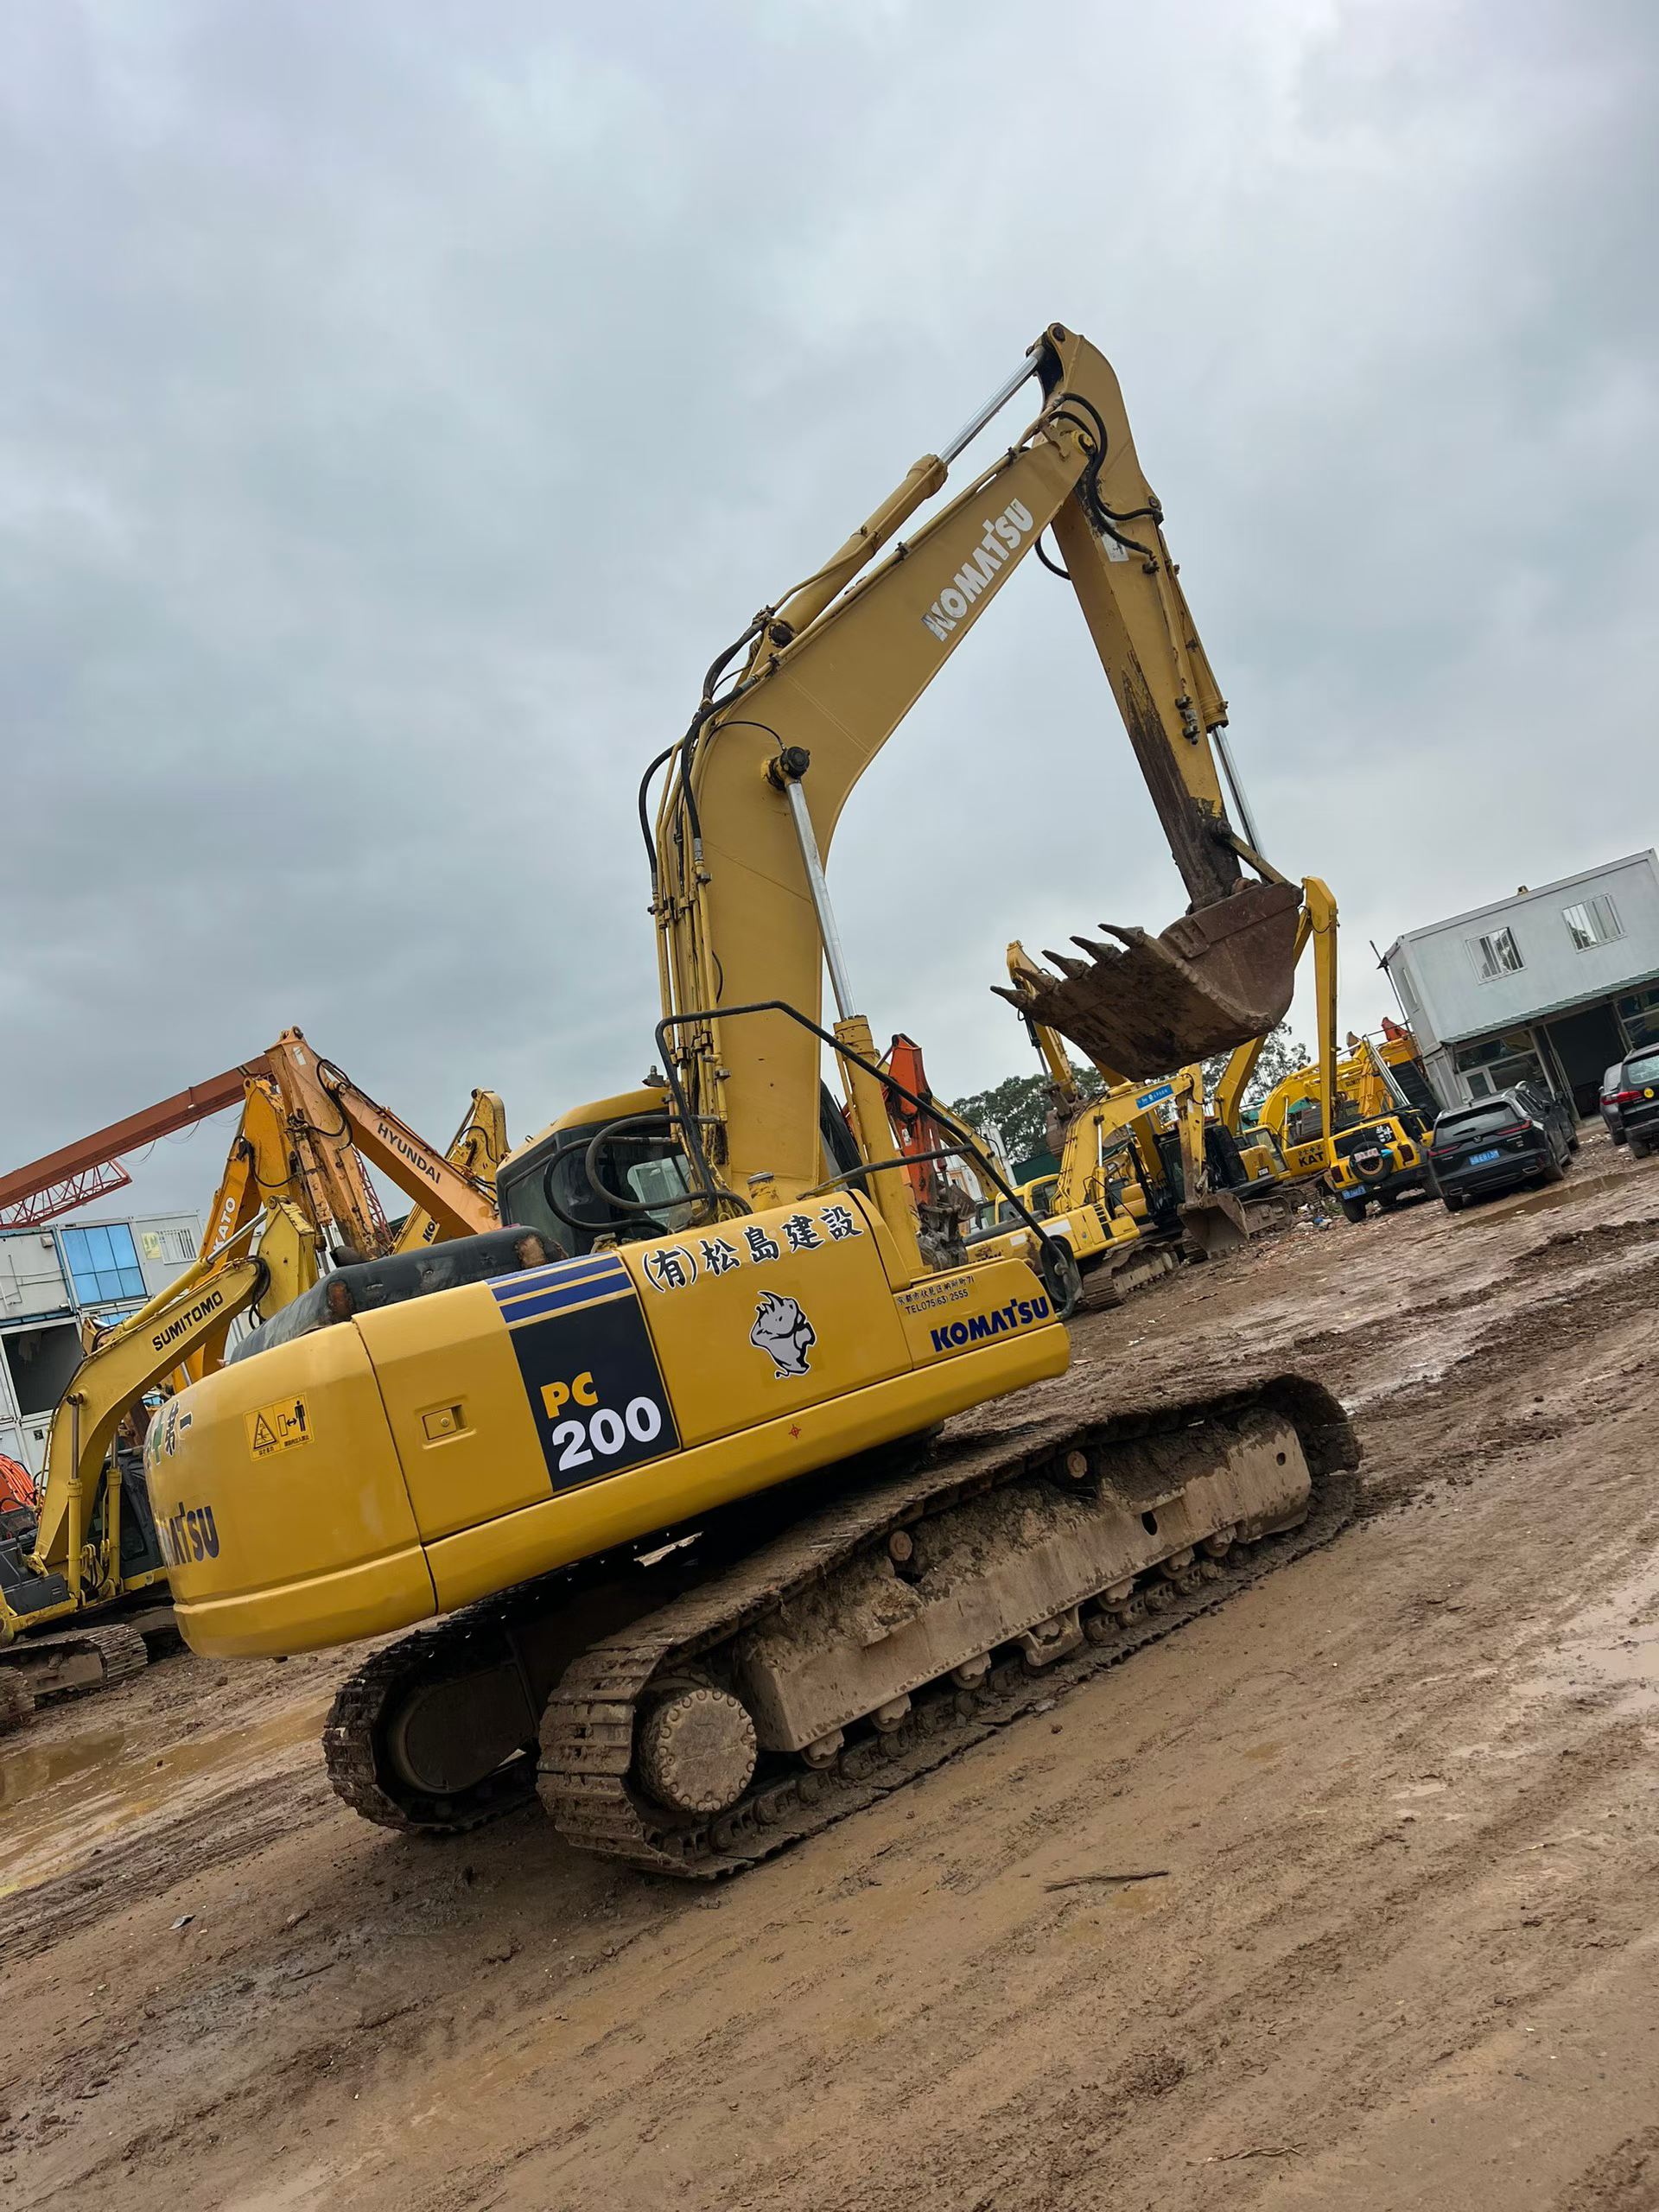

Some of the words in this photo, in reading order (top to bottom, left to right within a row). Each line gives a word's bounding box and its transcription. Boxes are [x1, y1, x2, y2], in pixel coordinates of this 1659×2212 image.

[920, 498, 1033, 641] KOMATSU
[378, 1123, 442, 1185] HYUNDAI
[423, 1217, 436, 1243] KO
[643, 1205, 863, 1293] (有)松島建設
[152, 1290, 224, 1351] SUMITOMO
[930, 1296, 1050, 1352] KOMATSU
[540, 1371, 599, 1419] PC
[552, 1396, 662, 1471] 200
[167, 1501, 220, 1567] ATSU
